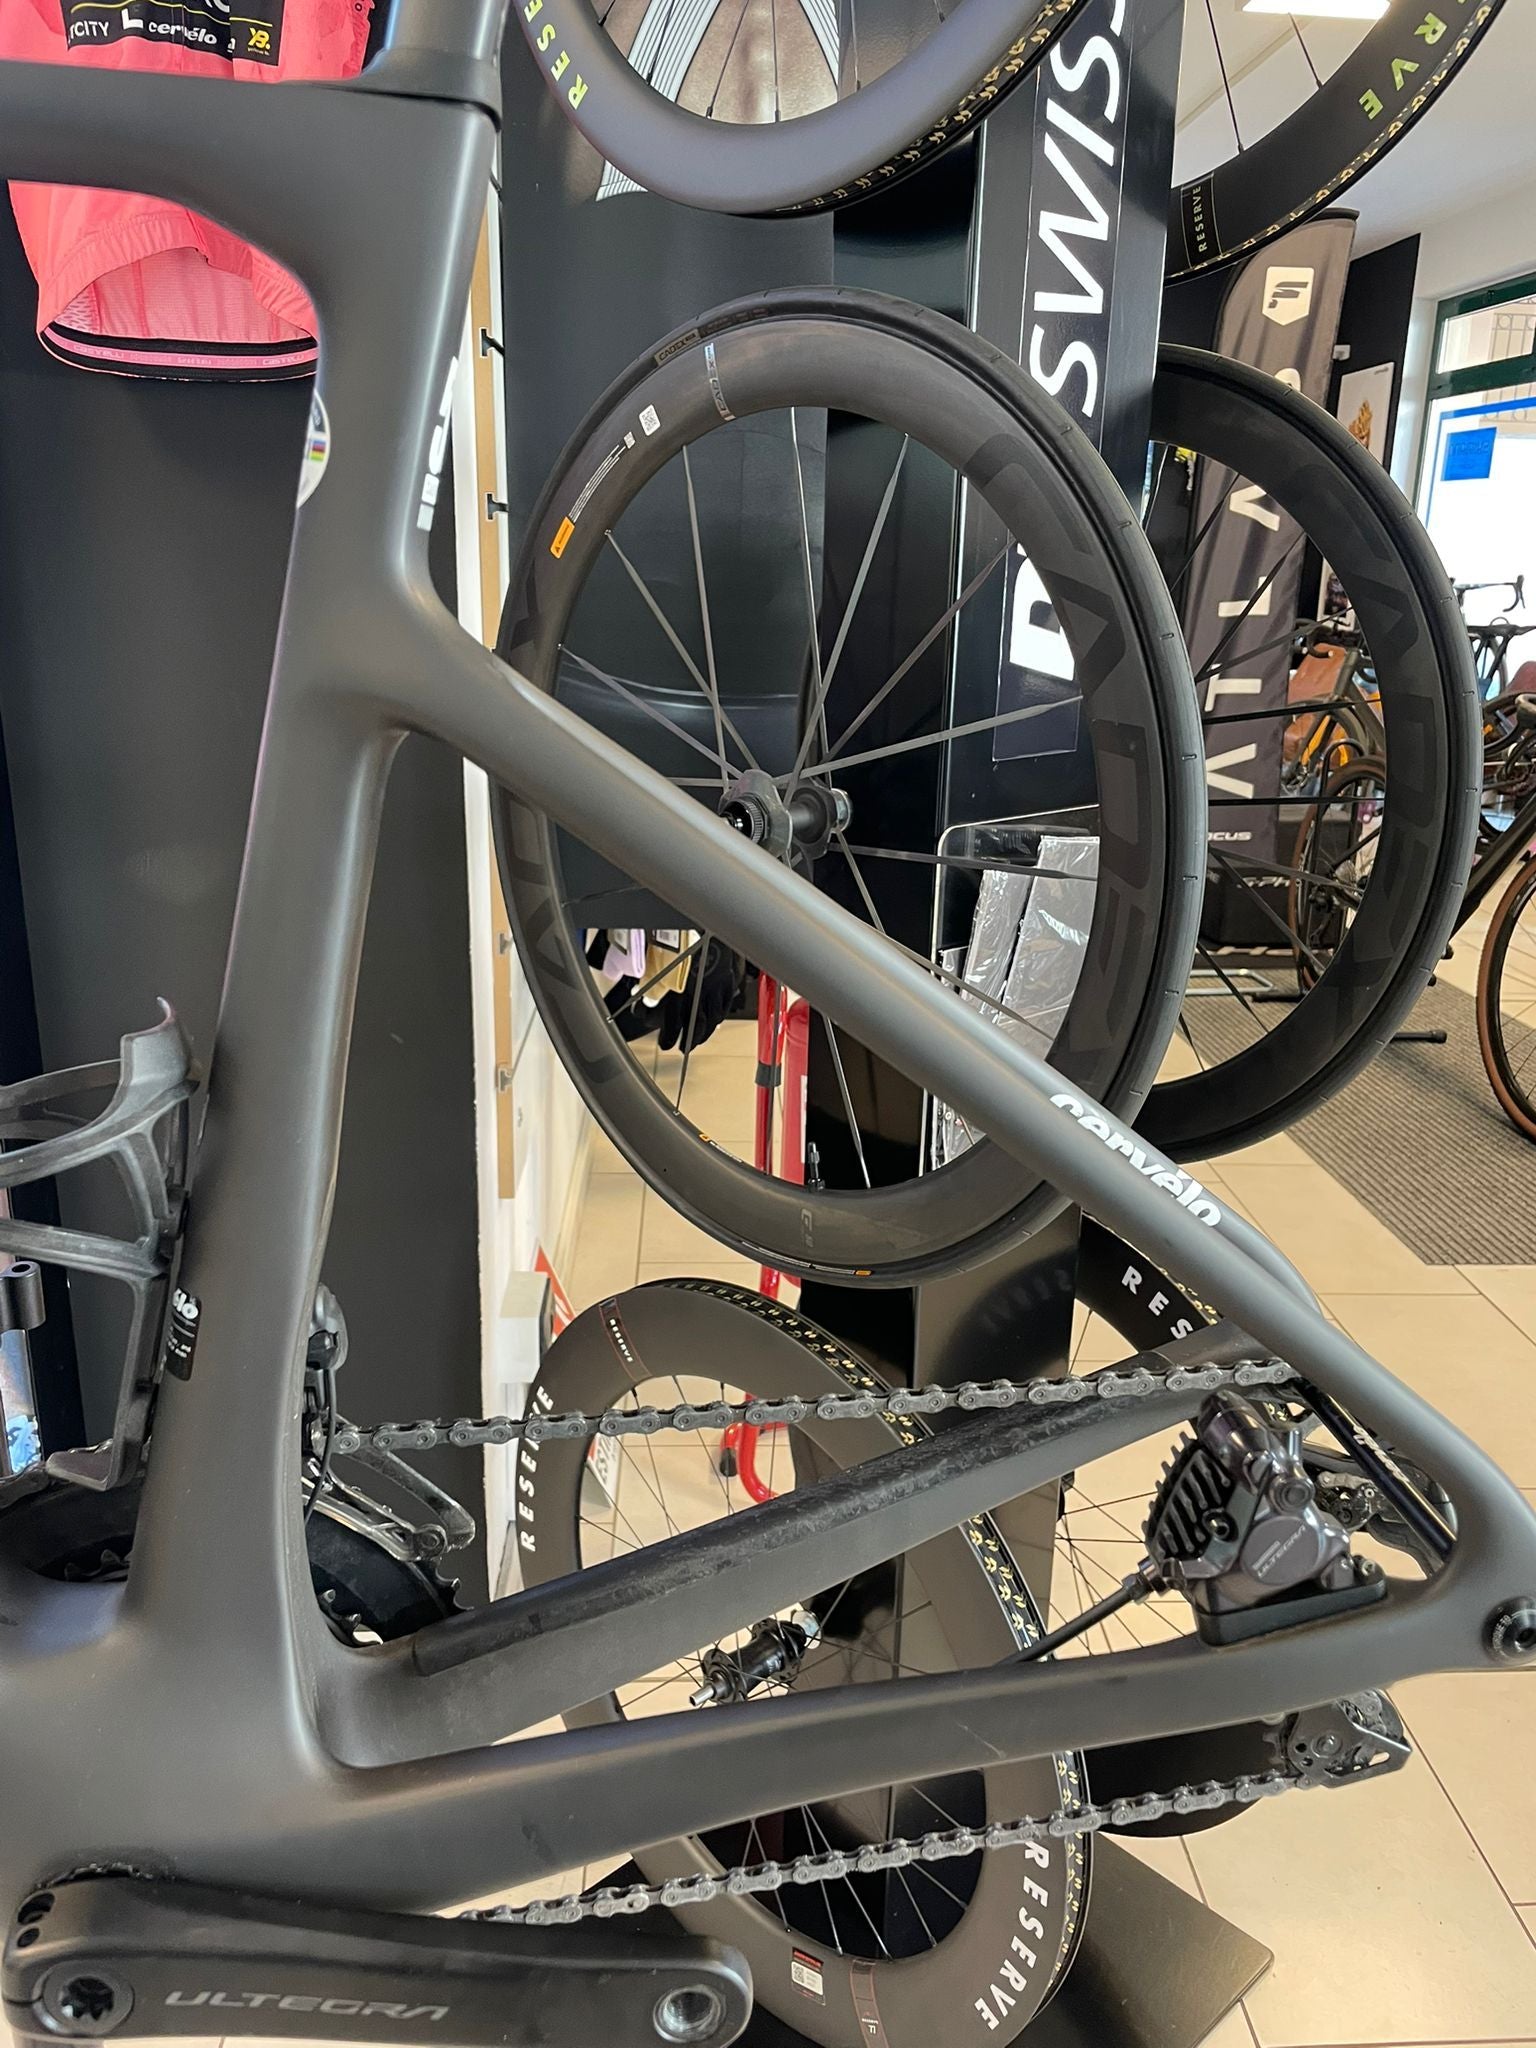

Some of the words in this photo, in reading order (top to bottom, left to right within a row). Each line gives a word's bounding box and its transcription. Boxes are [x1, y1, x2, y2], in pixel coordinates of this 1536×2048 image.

[1359, 0, 1467, 120] RVE
[1029, 0, 1126, 418] SWIS
[1192, 186, 1208, 253] RESERVE
[609, 1317, 633, 1363] RESERVE
[1121, 1265, 1194, 1340] RES
[518, 1385, 554, 1553] RESEE
[974, 1840, 1050, 2031] RESERVE
[165, 1991, 449, 2021] ULTEGRA
